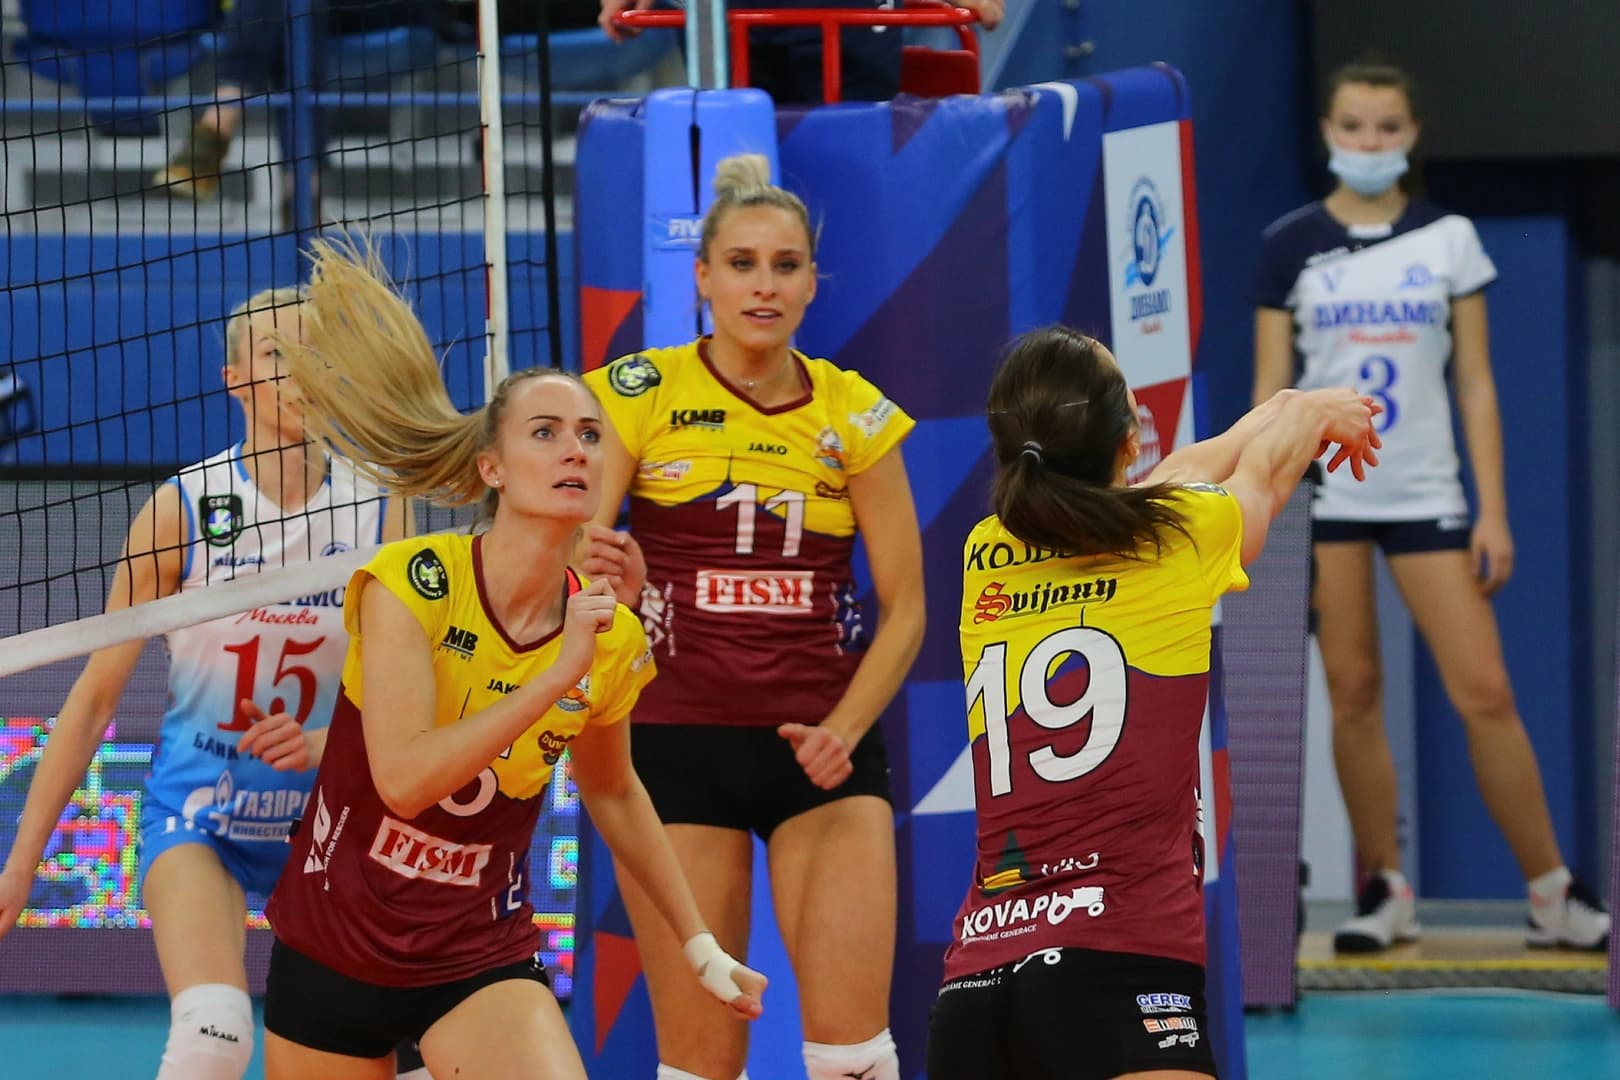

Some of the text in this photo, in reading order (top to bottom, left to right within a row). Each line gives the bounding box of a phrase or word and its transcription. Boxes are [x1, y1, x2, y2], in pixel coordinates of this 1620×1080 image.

[669, 219, 705, 238] FIV
[1359, 355, 1400, 435] 3
[671, 409, 726, 427] KMB
[747, 442, 788, 455] JAKO
[716, 483, 805, 557] 11
[708, 576, 802, 606] FISM
[973, 576, 1118, 625] Svijany
[235, 607, 320, 625] Москва
[444, 625, 479, 651] MB
[217, 634, 327, 732] 15
[486, 679, 521, 695] JAK
[965, 626, 1128, 797] 19
[379, 828, 481, 878] FISM
[1136, 993, 1192, 1010] GEREX
